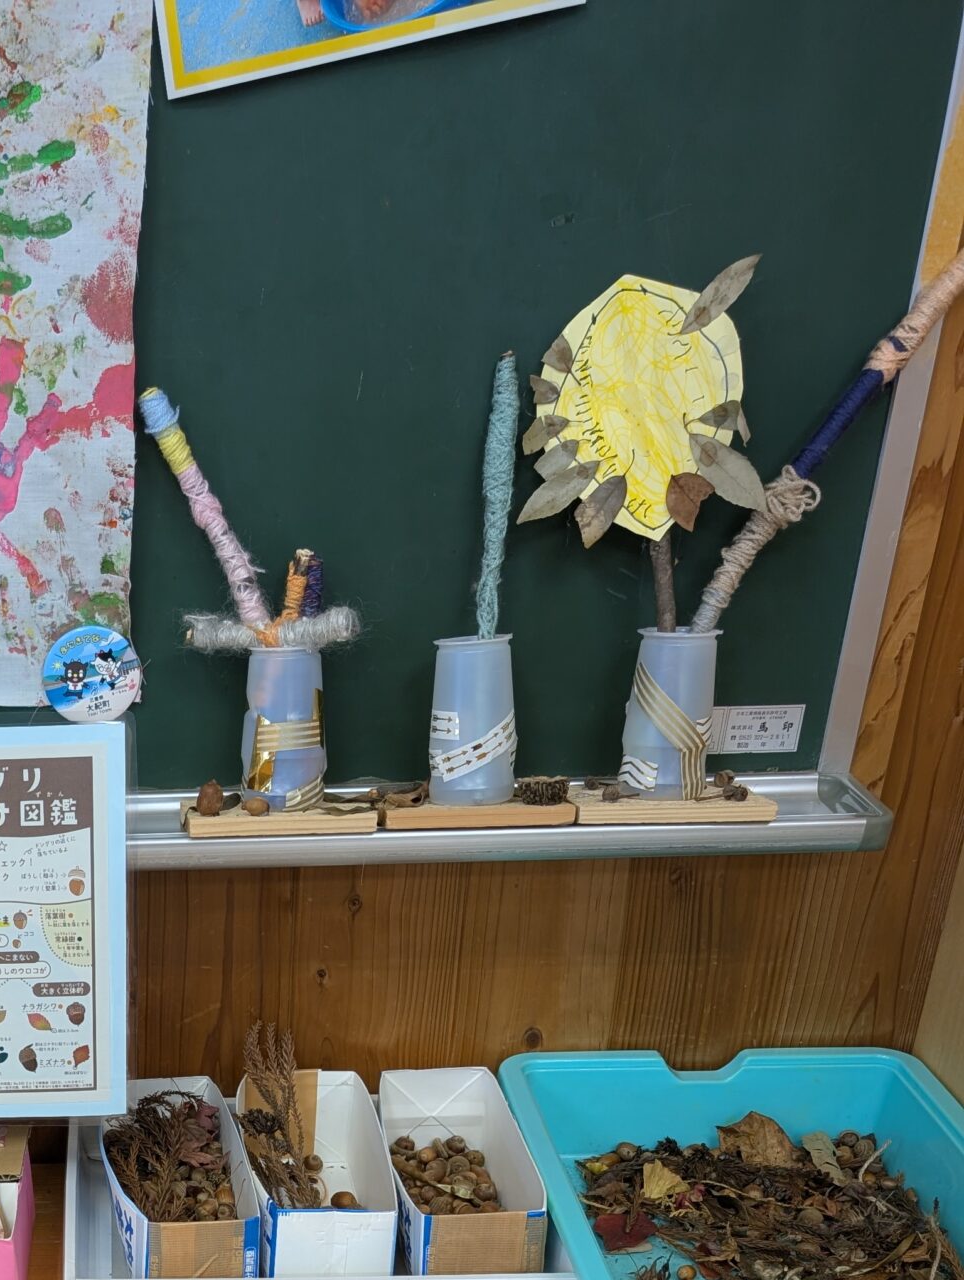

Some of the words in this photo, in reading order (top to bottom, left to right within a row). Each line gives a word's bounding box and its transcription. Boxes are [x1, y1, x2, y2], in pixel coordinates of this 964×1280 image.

[86, 700, 110, 713] 大紀町
[757, 721, 768, 733] 馬
[782, 721, 794, 733] 印
[40, 986, 84, 995] 大きく立体的
[21, 1002, 57, 1010] ナラガシワ
[39, 1059, 66, 1067] ミズナラ
